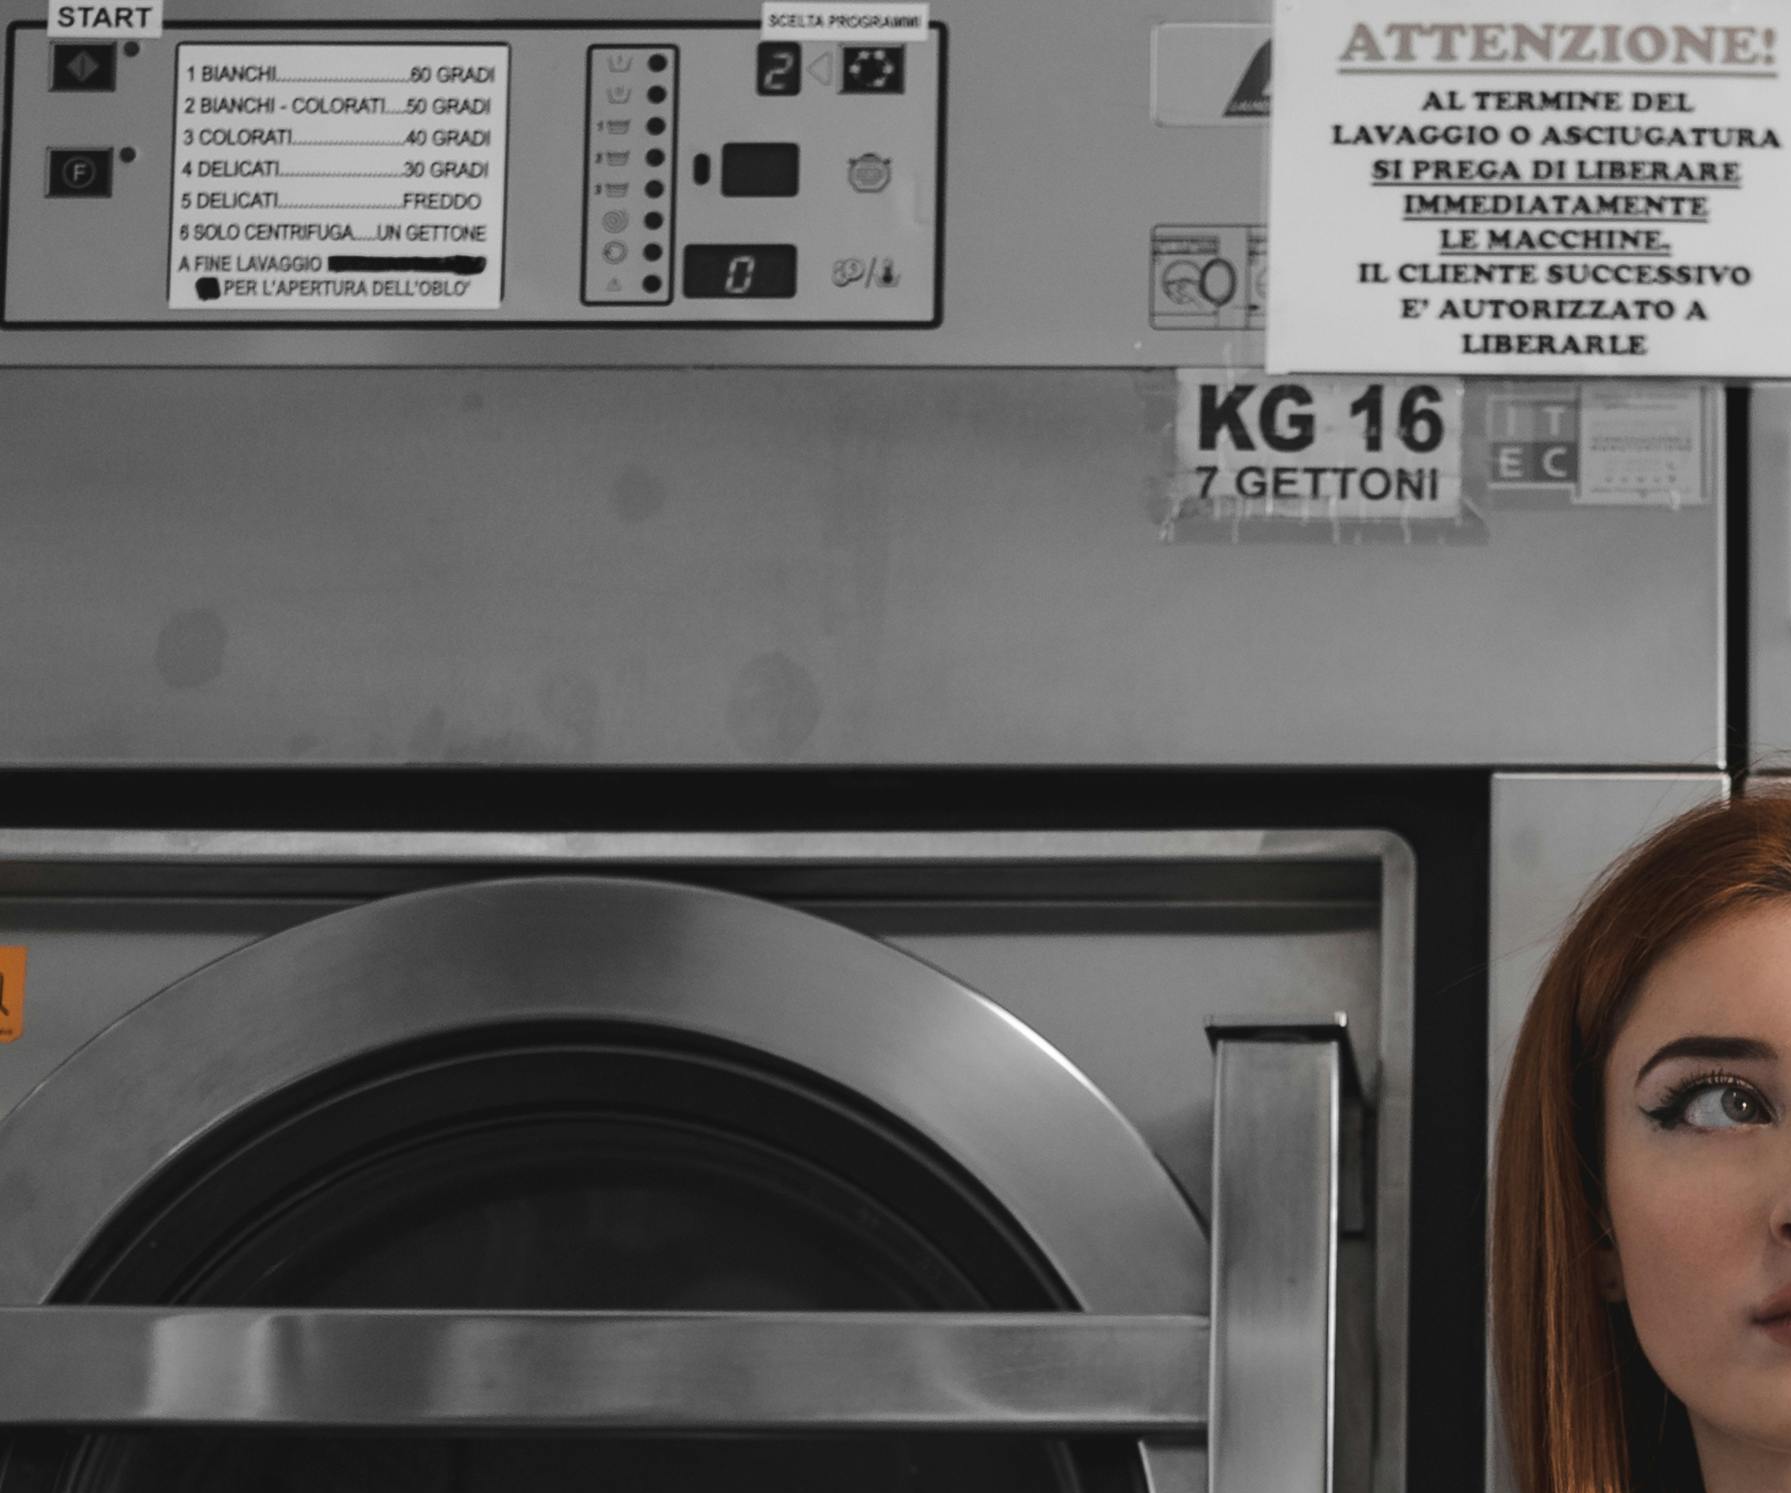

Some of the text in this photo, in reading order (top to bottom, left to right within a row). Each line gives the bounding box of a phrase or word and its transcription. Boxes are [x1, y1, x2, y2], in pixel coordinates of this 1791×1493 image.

[57, 6, 153, 28] START
[1338, 22, 1778, 65] ATTENZIONE!
[202, 65, 276, 82] BIANCHI
[436, 66, 495, 83] GRADI
[764, 52, 794, 90] 2
[184, 97, 195, 114] 2
[200, 97, 275, 114] BIANCHI
[292, 97, 385, 114] COLORATI
[406, 98, 427, 115] 50
[432, 98, 491, 115] GRADI
[1421, 90, 1695, 113] AL TERMINE DEL
[183, 128, 491, 147] 3 COLORATI 40 GRADI
[1331, 124, 1782, 149] LAVAGGIO O ASCIUGATURA
[182, 160, 489, 178] 4 DELICATI 30 GRADI
[1371, 159, 1742, 183] SI PREGA DI LIBERARE
[181, 192, 482, 210] 5 DELICATI FREDDO
[1403, 194, 1710, 217] IMMEDIATAMENTE
[193, 223, 240, 241] SOLO
[244, 224, 353, 241] CENTRIFUGA
[376, 225, 401, 241] UN
[406, 225, 487, 242] GETTONE
[1439, 229, 1672, 251] LE MACCHINE.
[178, 256, 322, 272] A FINE LAVAGGIO
[724, 255, 755, 293] 0
[1357, 262, 1752, 286] IL CLIENTE SUCCESSIVO
[223, 279, 257, 296] PER
[262, 279, 367, 296] L'APERTURA
[1439, 298, 1676, 321] AUTORIZZATO
[1685, 300, 1709, 321] A
[1461, 333, 1648, 356] LIBERARLE
[1198, 383, 1445, 453] KG 16
[1195, 465, 1439, 502] 7 GETTONI
